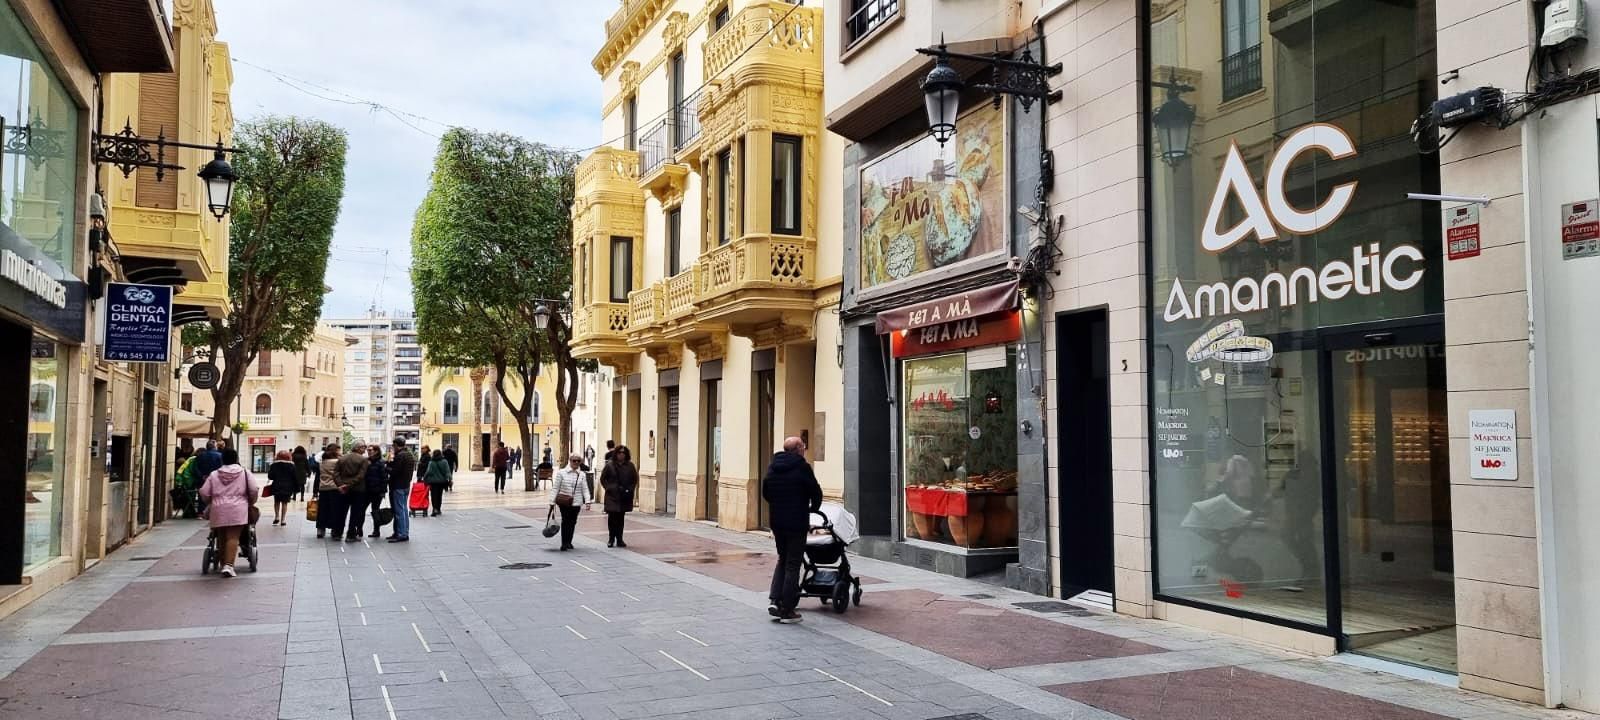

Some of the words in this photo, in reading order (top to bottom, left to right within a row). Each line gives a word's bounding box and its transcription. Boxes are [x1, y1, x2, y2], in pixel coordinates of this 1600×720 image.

[1200, 122, 1359, 256] AC
[894, 209, 900, 221] a
[1450, 227, 1477, 237] Alarma
[1564, 224, 1598, 236] Alarma
[1163, 242, 1427, 323] Amannetic
[111, 304, 166, 314] CLINICA
[931, 306, 940, 322] A
[111, 313, 165, 323] DENTAL
[941, 323, 951, 342] A
[1474, 433, 1512, 441] MAJORICA
